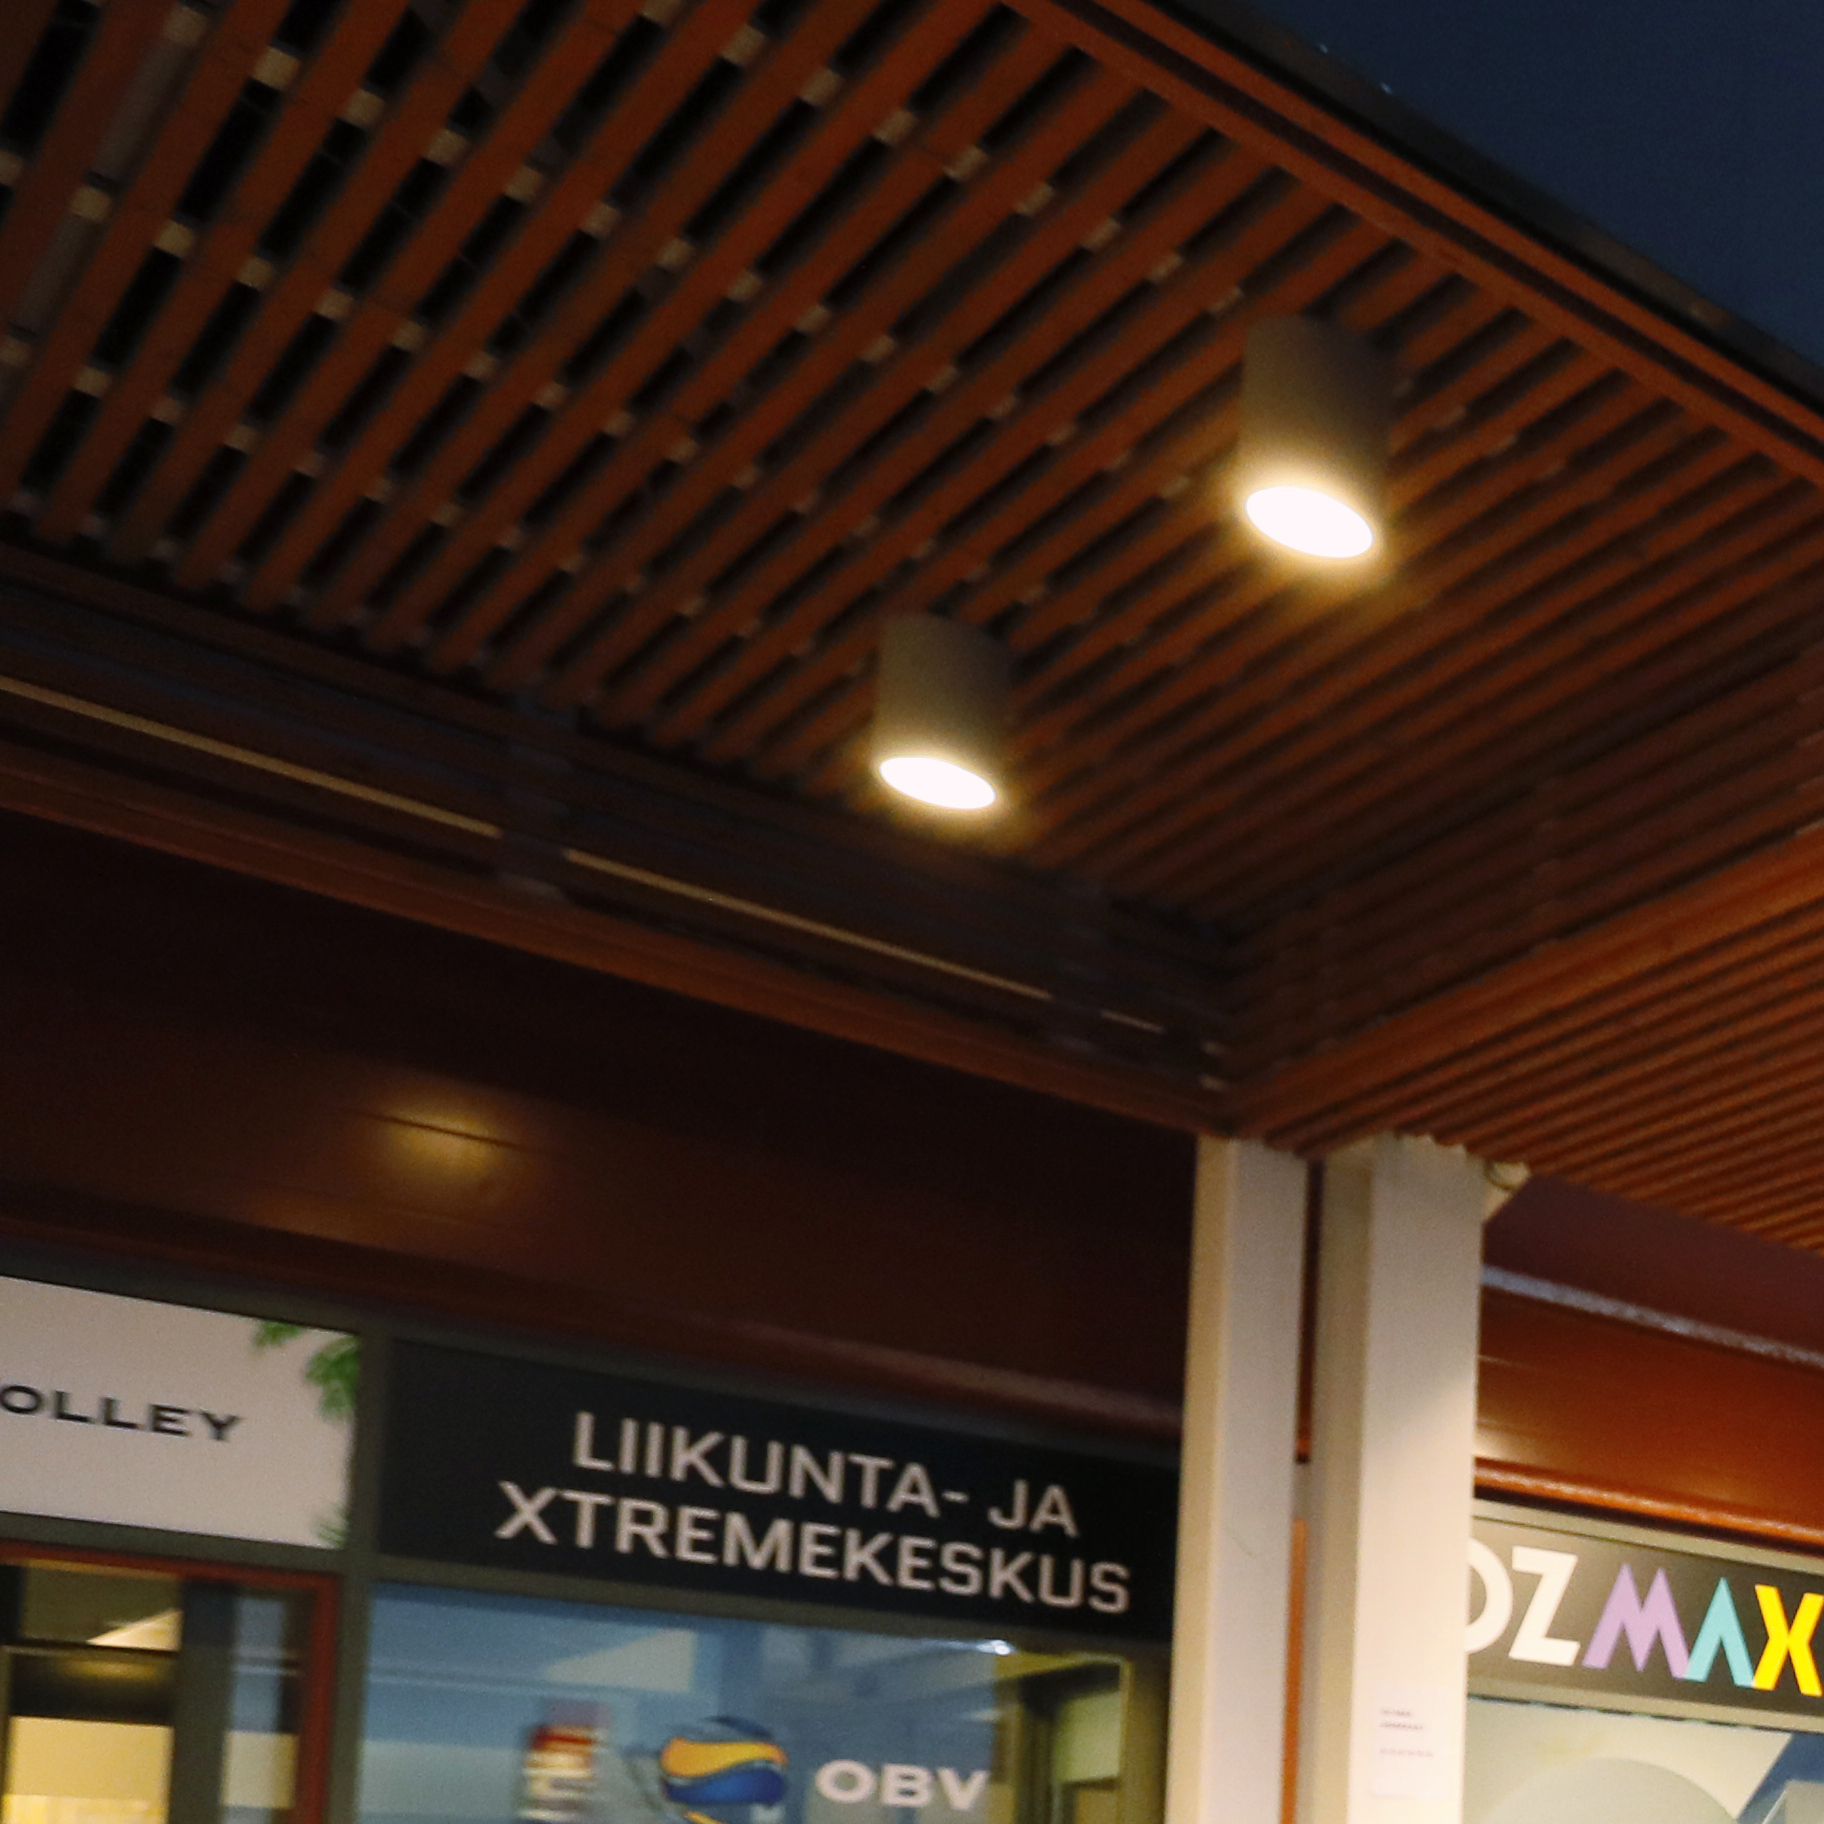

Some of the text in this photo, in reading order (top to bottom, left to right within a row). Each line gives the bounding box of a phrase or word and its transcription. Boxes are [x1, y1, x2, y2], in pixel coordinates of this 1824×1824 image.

[573, 1411, 1079, 1537] LIIKUNTA- JA
[495, 1479, 1131, 1614] XTREMEKESKUS
[815, 1759, 991, 1811] OBV
